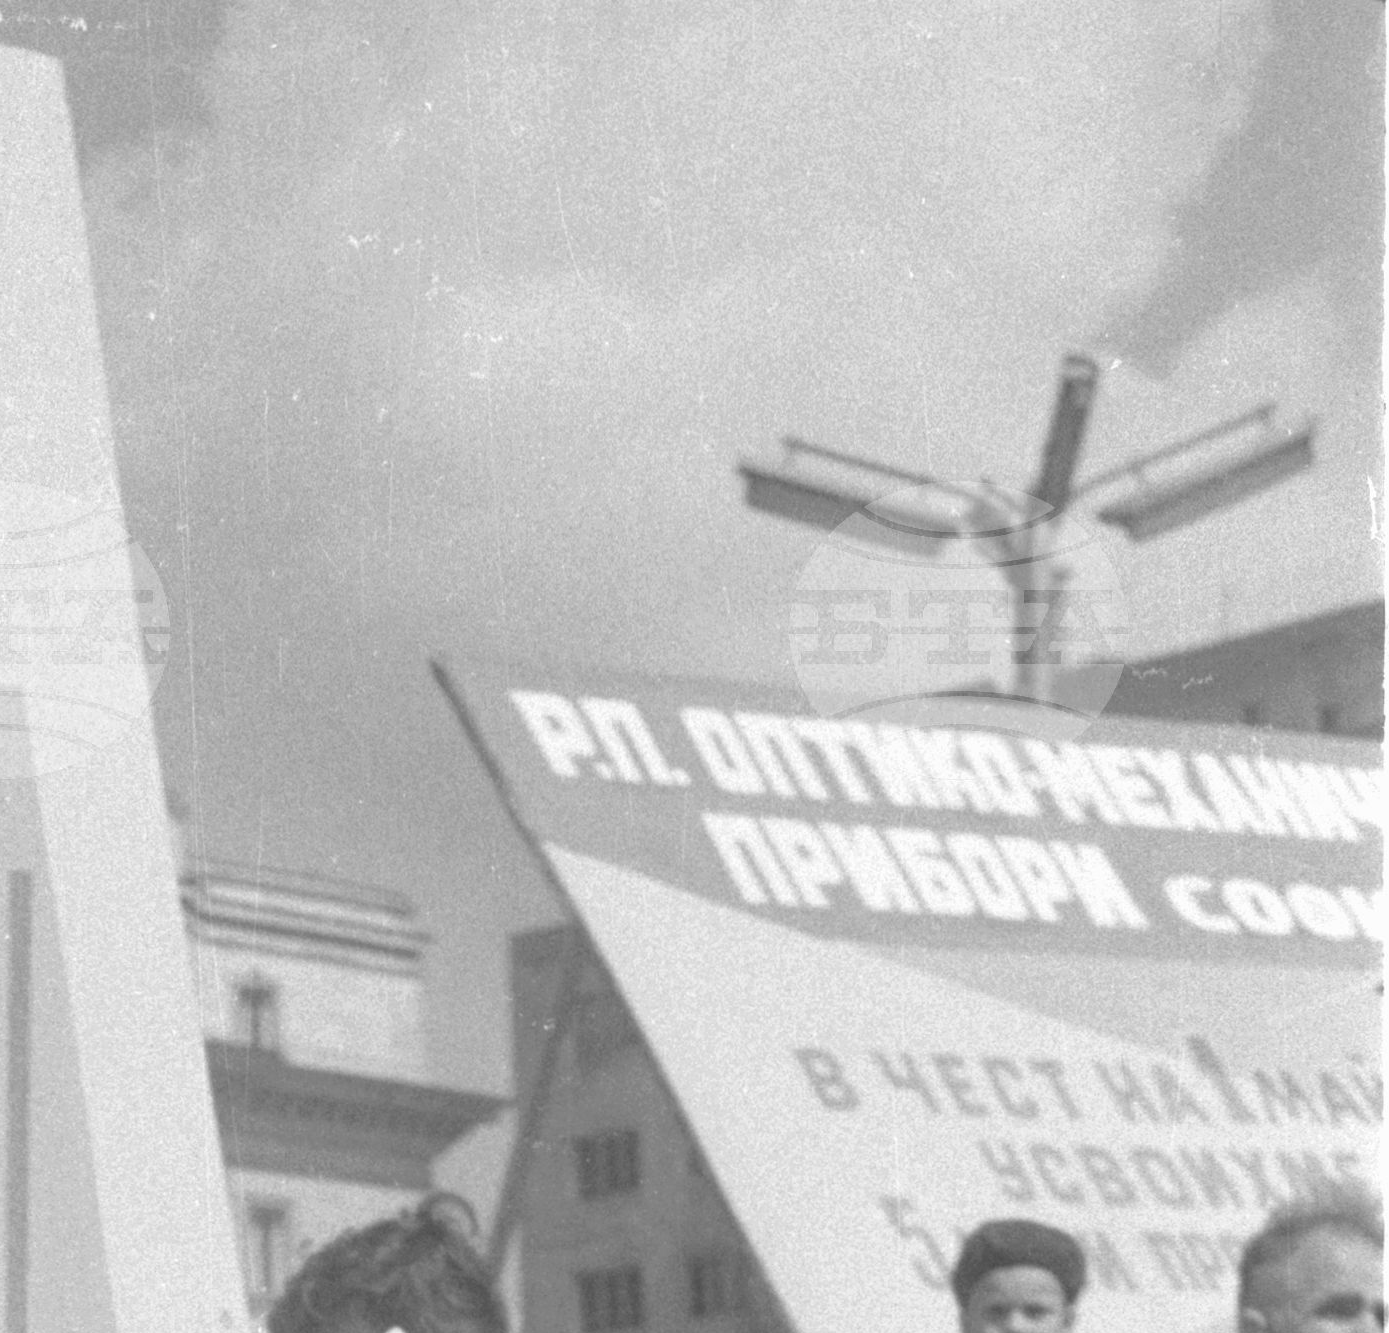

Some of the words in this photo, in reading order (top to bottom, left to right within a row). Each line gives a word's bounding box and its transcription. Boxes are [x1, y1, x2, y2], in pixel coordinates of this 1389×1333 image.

[702, 811, 1147, 929] ПРИБОРИ
[792, 1045, 862, 1114] В
[867, 1049, 1084, 1121] ЧЕСТ
[1092, 1060, 1211, 1124] НА
